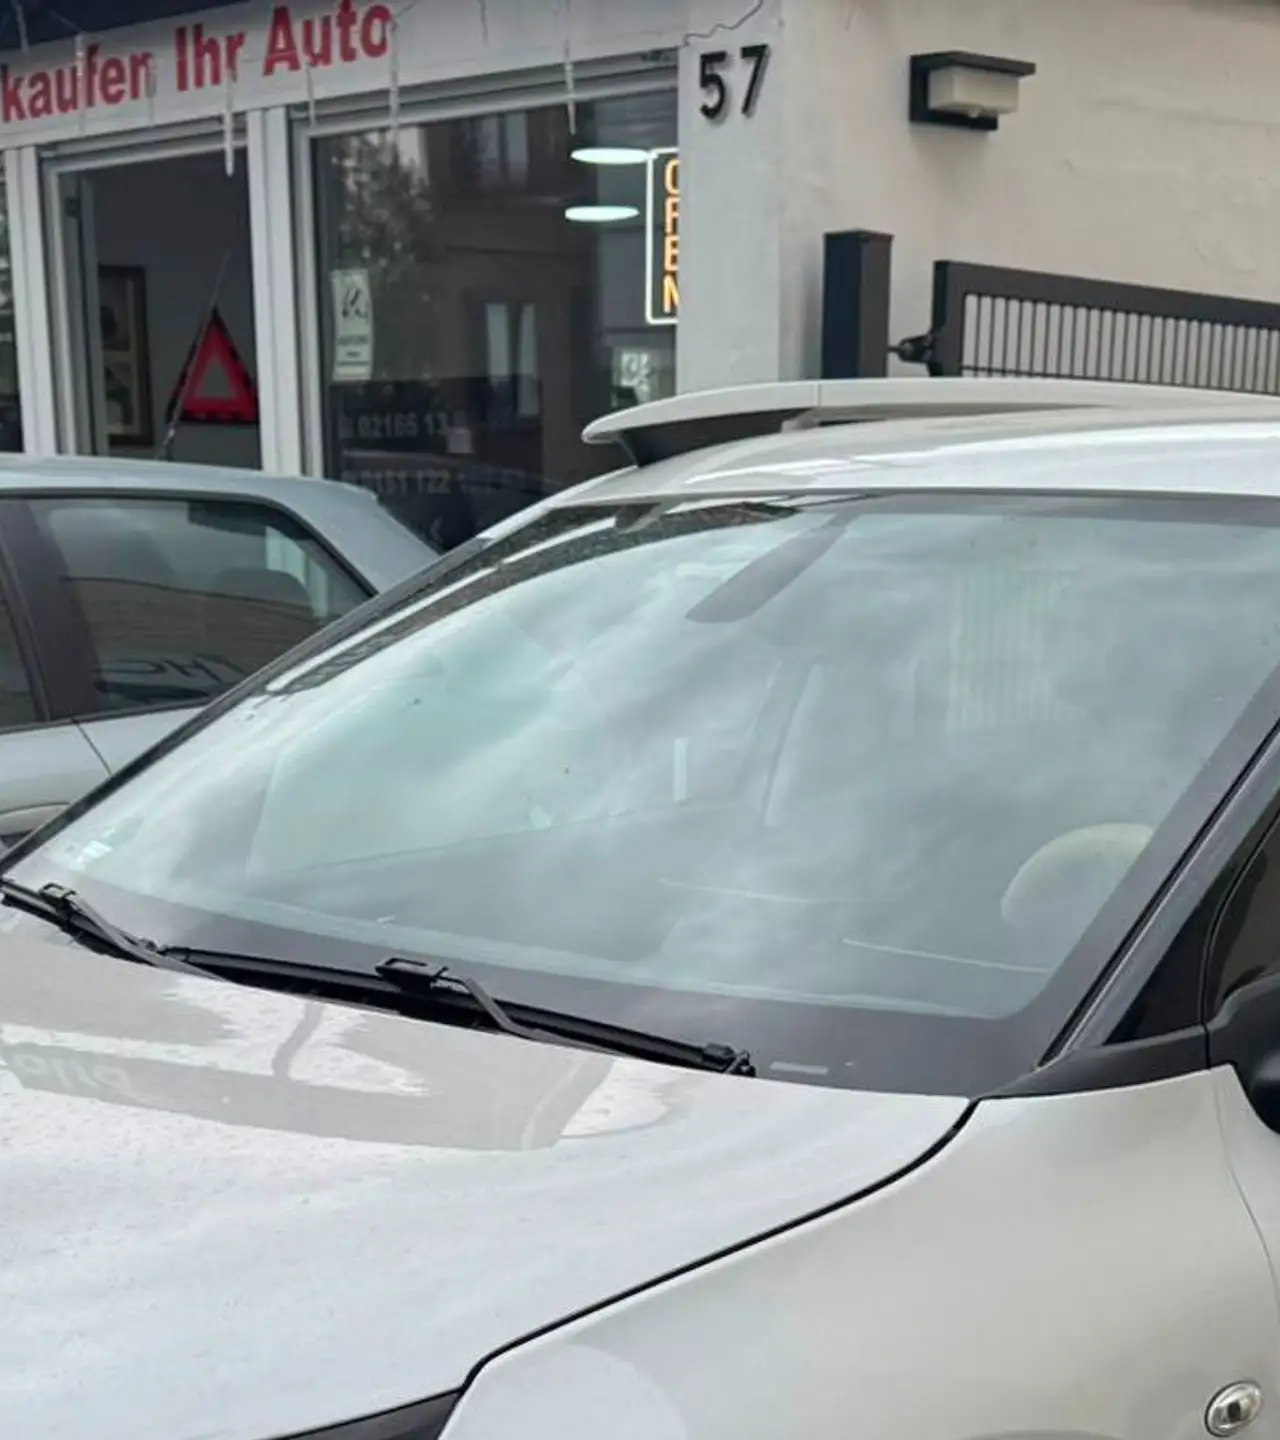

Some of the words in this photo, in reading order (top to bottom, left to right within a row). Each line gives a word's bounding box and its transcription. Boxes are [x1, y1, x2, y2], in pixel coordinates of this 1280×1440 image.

[0, 43, 157, 124] kaufen
[175, 22, 246, 92] Ihr
[262, 0, 392, 77] Auto
[699, 43, 771, 120] 57
